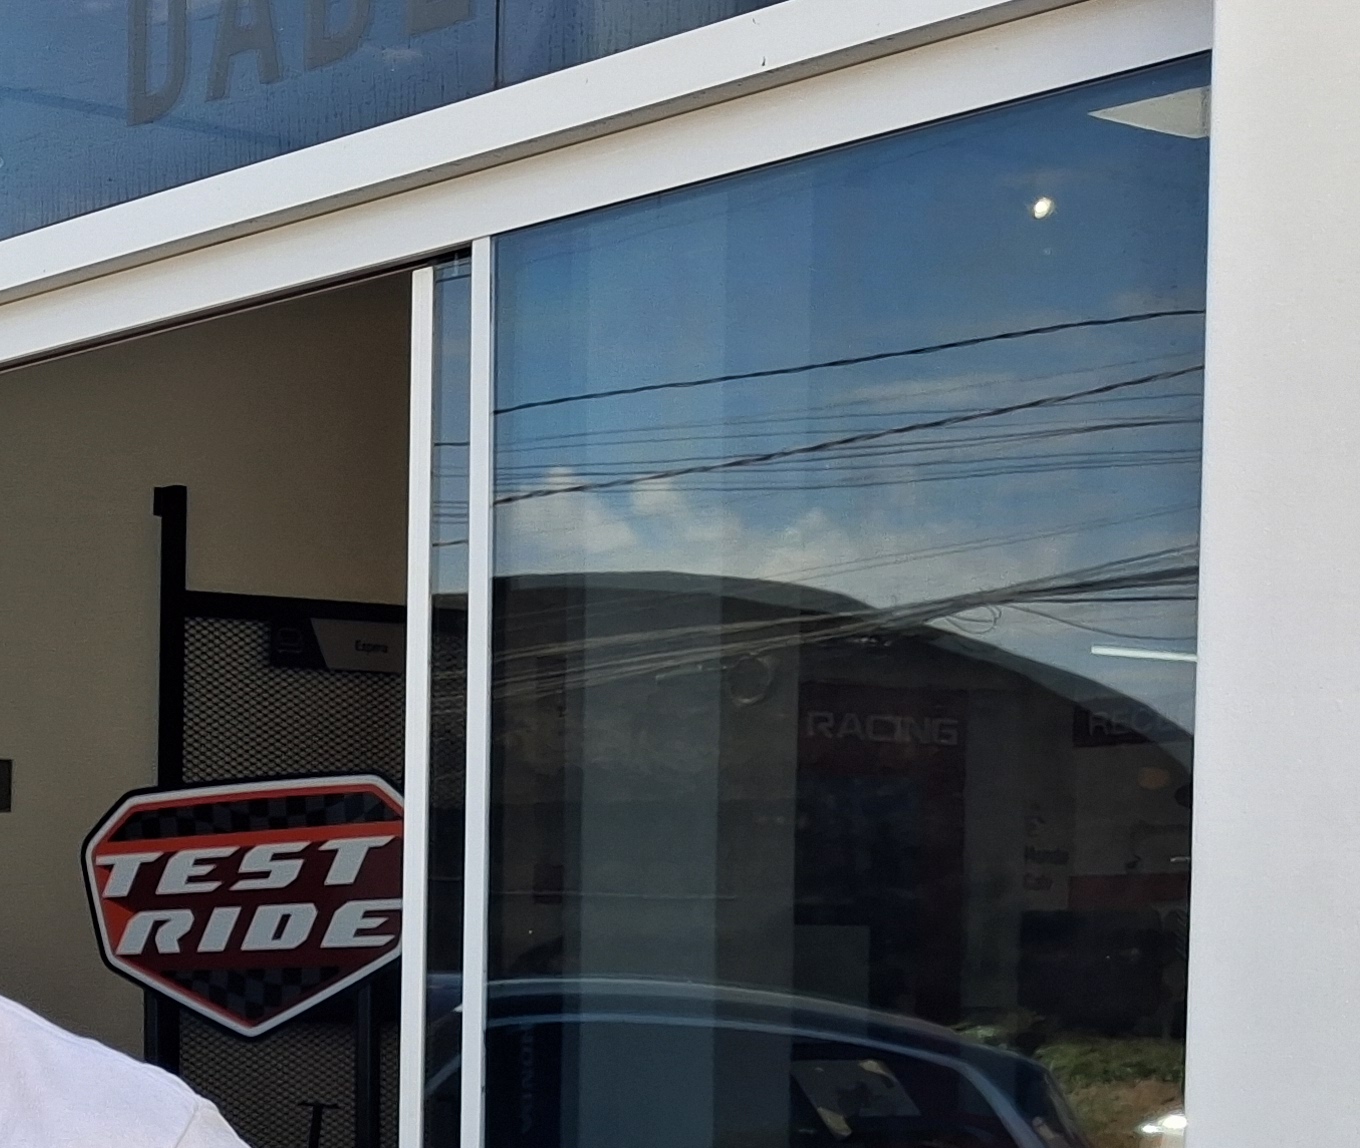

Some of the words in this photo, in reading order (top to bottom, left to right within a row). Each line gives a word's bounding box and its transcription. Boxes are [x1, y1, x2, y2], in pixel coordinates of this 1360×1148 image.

[127, 0, 476, 126] DA
[807, 710, 959, 746] RACING
[95, 835, 398, 899] TEST
[115, 898, 403, 955] RIDE
